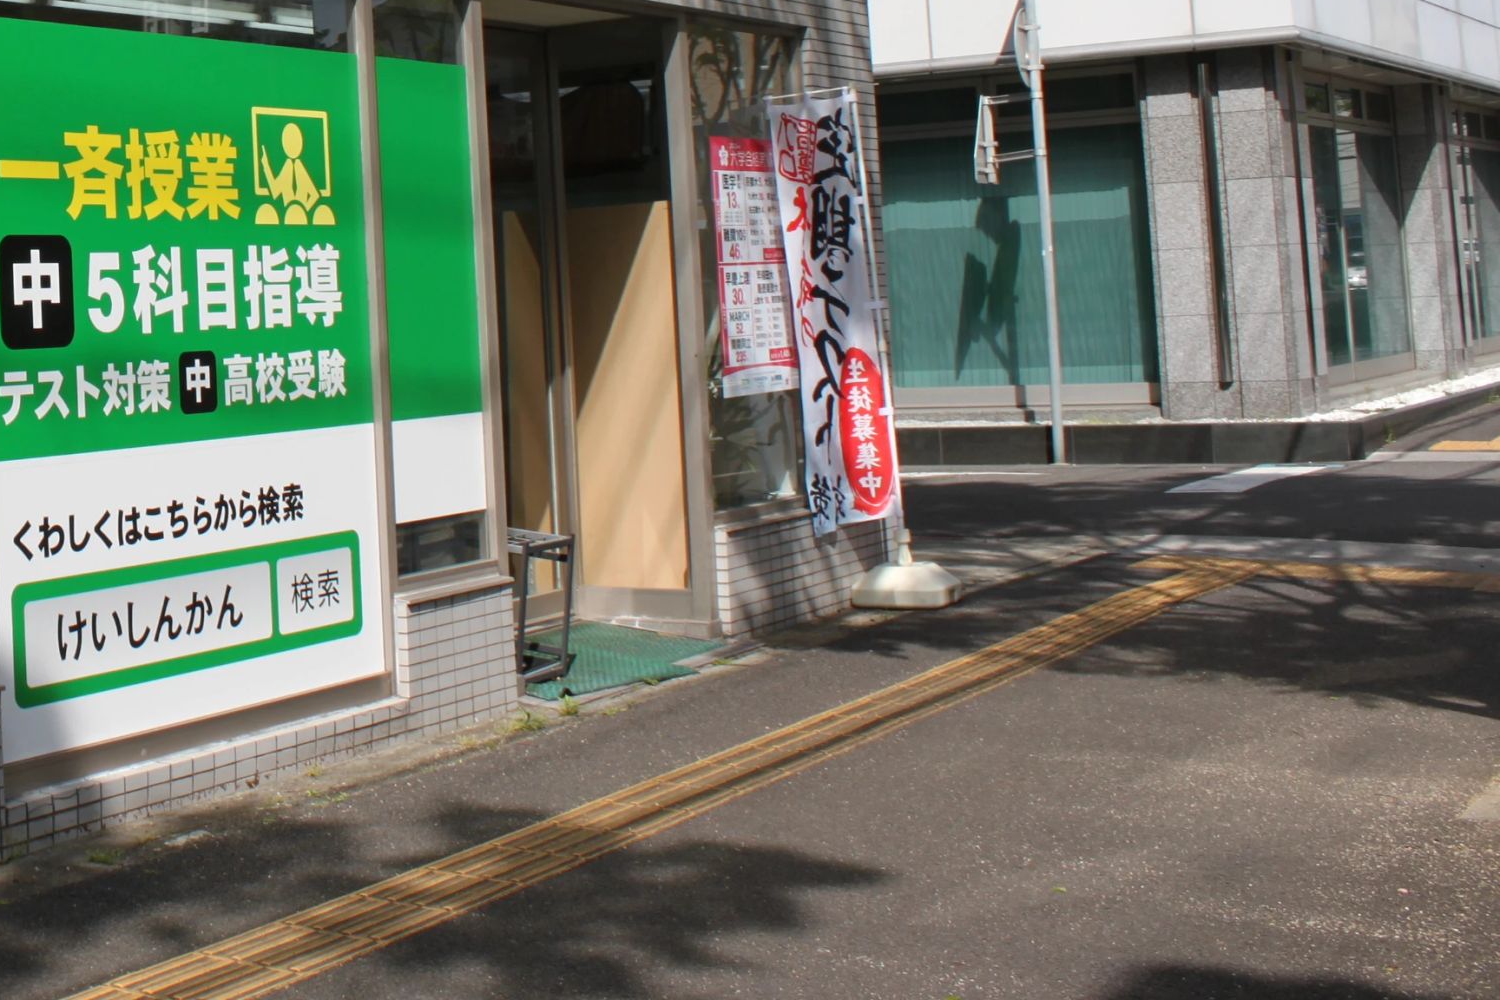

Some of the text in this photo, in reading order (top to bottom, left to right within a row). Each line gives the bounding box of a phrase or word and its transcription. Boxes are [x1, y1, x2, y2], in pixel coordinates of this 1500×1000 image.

[0, 125, 241, 222] 一斉授業
[12, 243, 342, 335] 中 5科目指導
[729, 311, 751, 322] MARCH
[0, 348, 347, 425] テスト対策 中 高校受験
[13, 483, 305, 561] くわしくはこちらから検索
[56, 568, 341, 661] けいしんかん 検索
